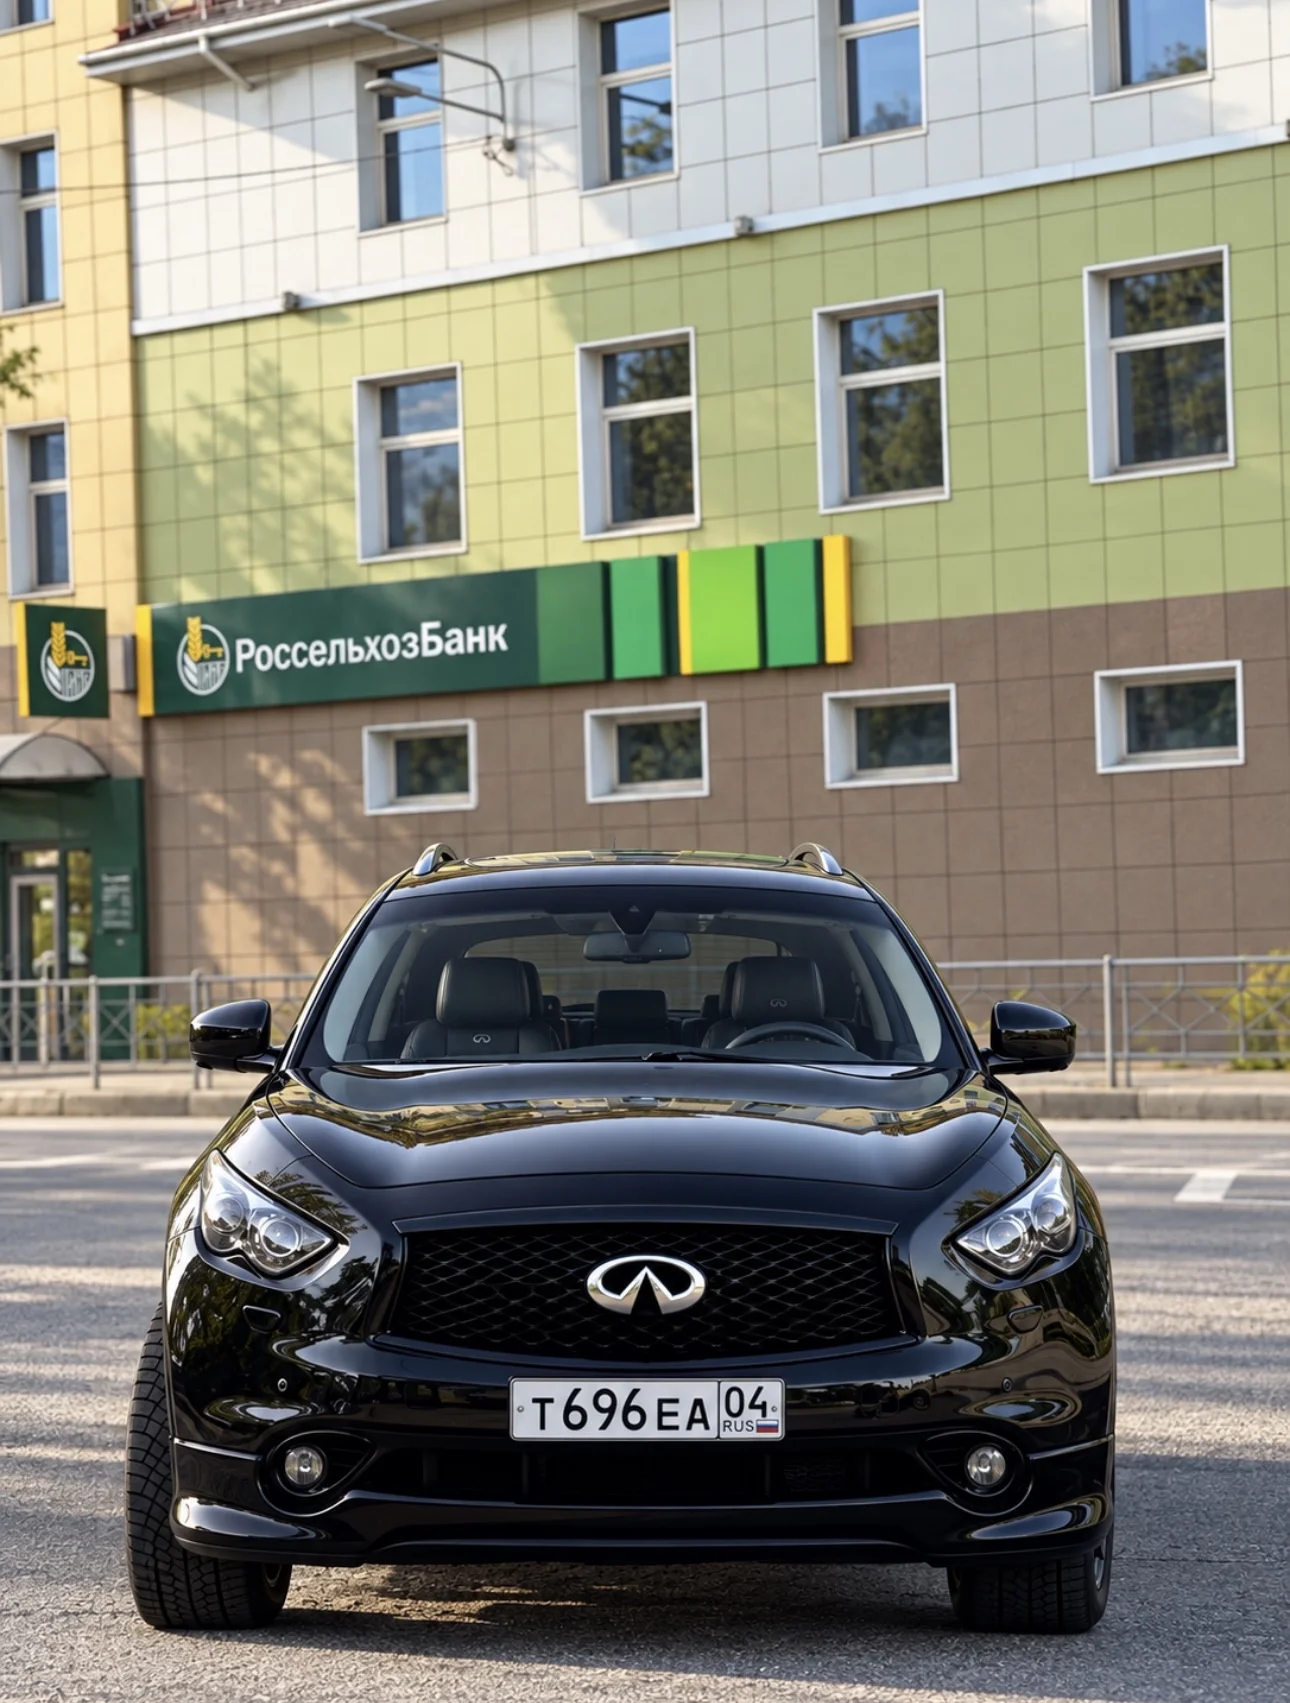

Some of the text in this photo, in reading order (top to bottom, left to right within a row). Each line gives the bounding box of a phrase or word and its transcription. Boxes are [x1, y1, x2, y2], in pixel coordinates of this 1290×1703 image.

[236, 621, 508, 673] РоссельхозБанк
[724, 1386, 767, 1417] 04
[723, 1420, 753, 1432] RUS
